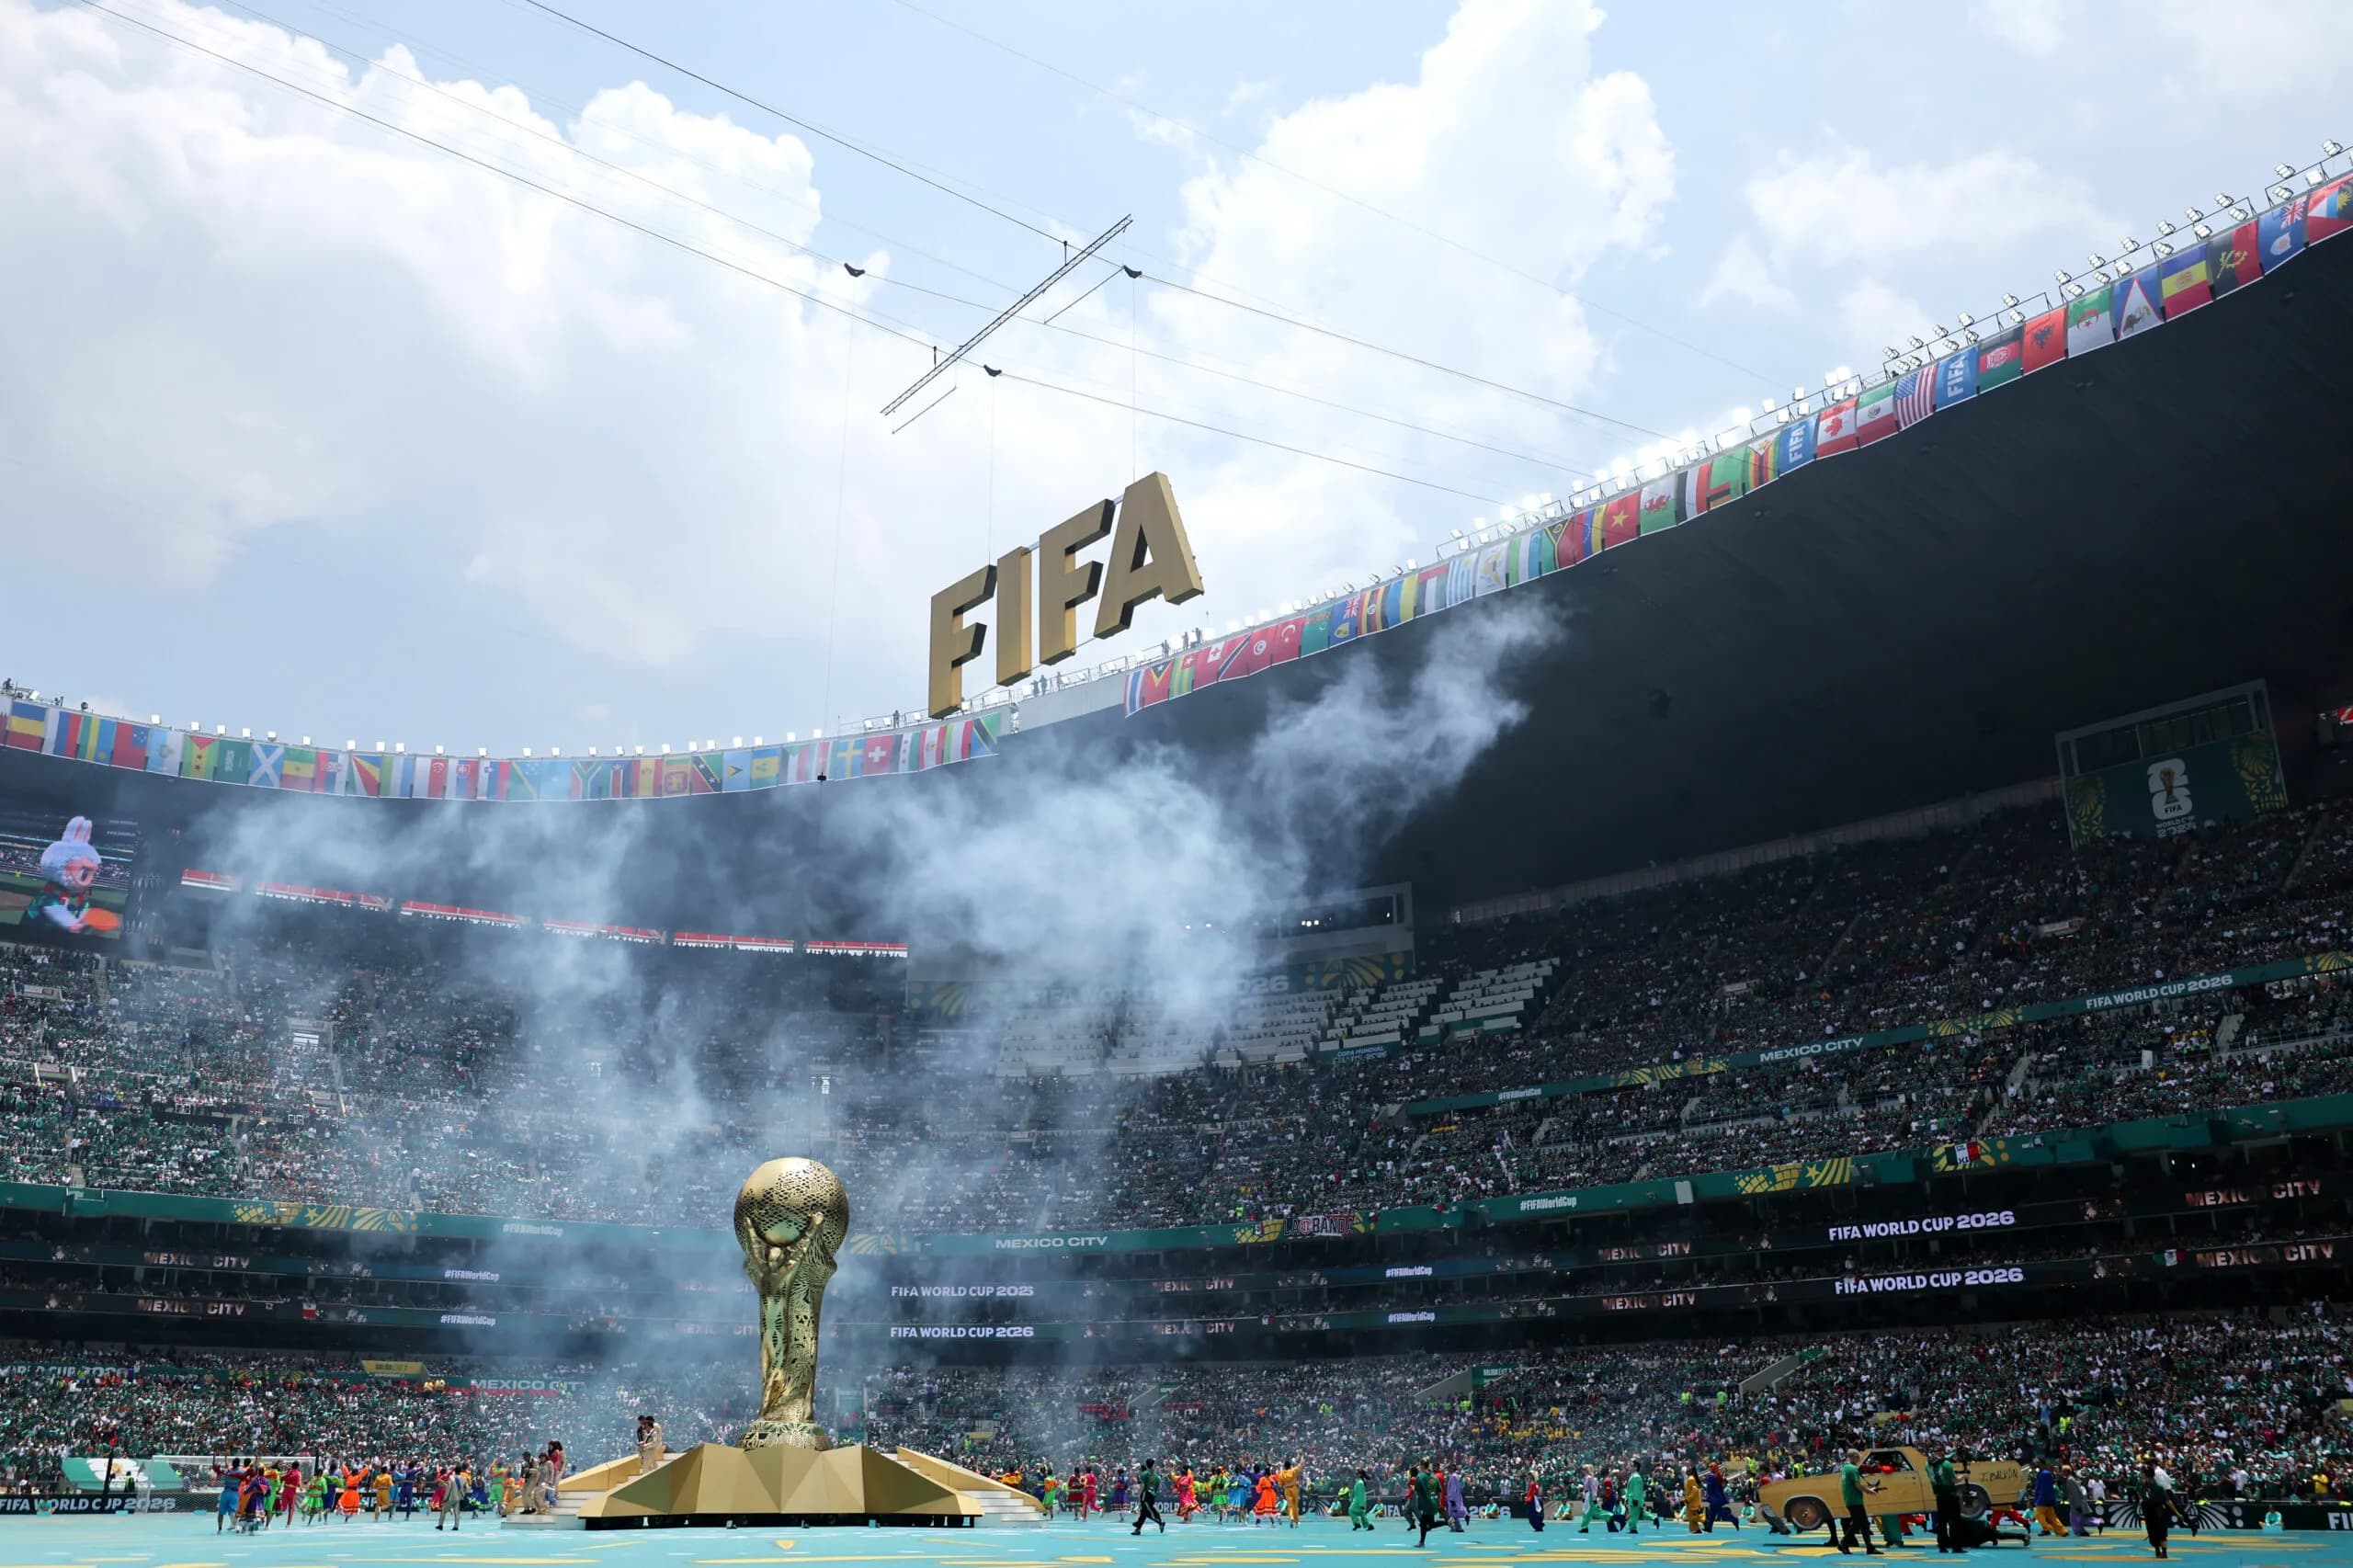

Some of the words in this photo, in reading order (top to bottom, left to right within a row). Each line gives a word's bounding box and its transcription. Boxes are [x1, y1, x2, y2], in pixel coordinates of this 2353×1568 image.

[1947, 353, 1967, 399] FIFA
[1789, 421, 1807, 464] FIFA
[927, 471, 1205, 720] FIFA
[2086, 996, 2113, 1010] FIFA
[2114, 988, 2159, 1006] WORLD
[2160, 983, 2186, 996] CUP
[2188, 974, 2234, 992] 2026
[1759, 1044, 1823, 1062] MEXICO
[1824, 1037, 1864, 1051] CITY
[2185, 1186, 2256, 1207] MEXIC
[2271, 1177, 2323, 1199] CITY
[1520, 1195, 1578, 1211] #FIFAWorldCup
[502, 1222, 564, 1238] #FIFAWorldCup
[1828, 1224, 1861, 1241] FIFA
[1862, 1220, 1920, 1238] WORLD
[1922, 1216, 1954, 1233] CUP
[1956, 1210, 2016, 1230] 2026
[995, 1237, 1064, 1249] MEXICO
[1067, 1235, 1108, 1246] CITY
[143, 1251, 198, 1267] MEXIC
[212, 1256, 250, 1268] CITY
[1597, 1245, 1646, 1261] MEXIC
[1658, 1243, 1692, 1256] CITY
[2284, 1243, 2334, 1262] CITY
[444, 1269, 500, 1282] #FIFAWorldCup
[1835, 1280, 1869, 1295] FIFA
[1870, 1275, 1927, 1292] WORLD
[1929, 1271, 1962, 1288] CUP
[1964, 1267, 2024, 1286] 2026
[891, 1286, 919, 1297] FIFA
[920, 1286, 966, 1297] WORLD
[969, 1286, 995, 1297] CUP
[1152, 1279, 1195, 1293] MEXIC
[1205, 1278, 1234, 1290] CITY
[137, 1299, 194, 1313] MEXIC
[206, 1301, 245, 1315] CITY
[1661, 1292, 1696, 1307] CITY
[440, 1314, 496, 1327] #FIFAWorldCup
[1206, 1322, 1235, 1334] CITY
[890, 1326, 919, 1337] FIFA
[919, 1326, 966, 1337] WORLD
[968, 1326, 995, 1337] CUP
[470, 1379, 546, 1390] MEXICO
[0, 1497, 31, 1512] FIFA
[124, 1497, 176, 1510] 2026
[1384, 1506, 1401, 1517] IFA
